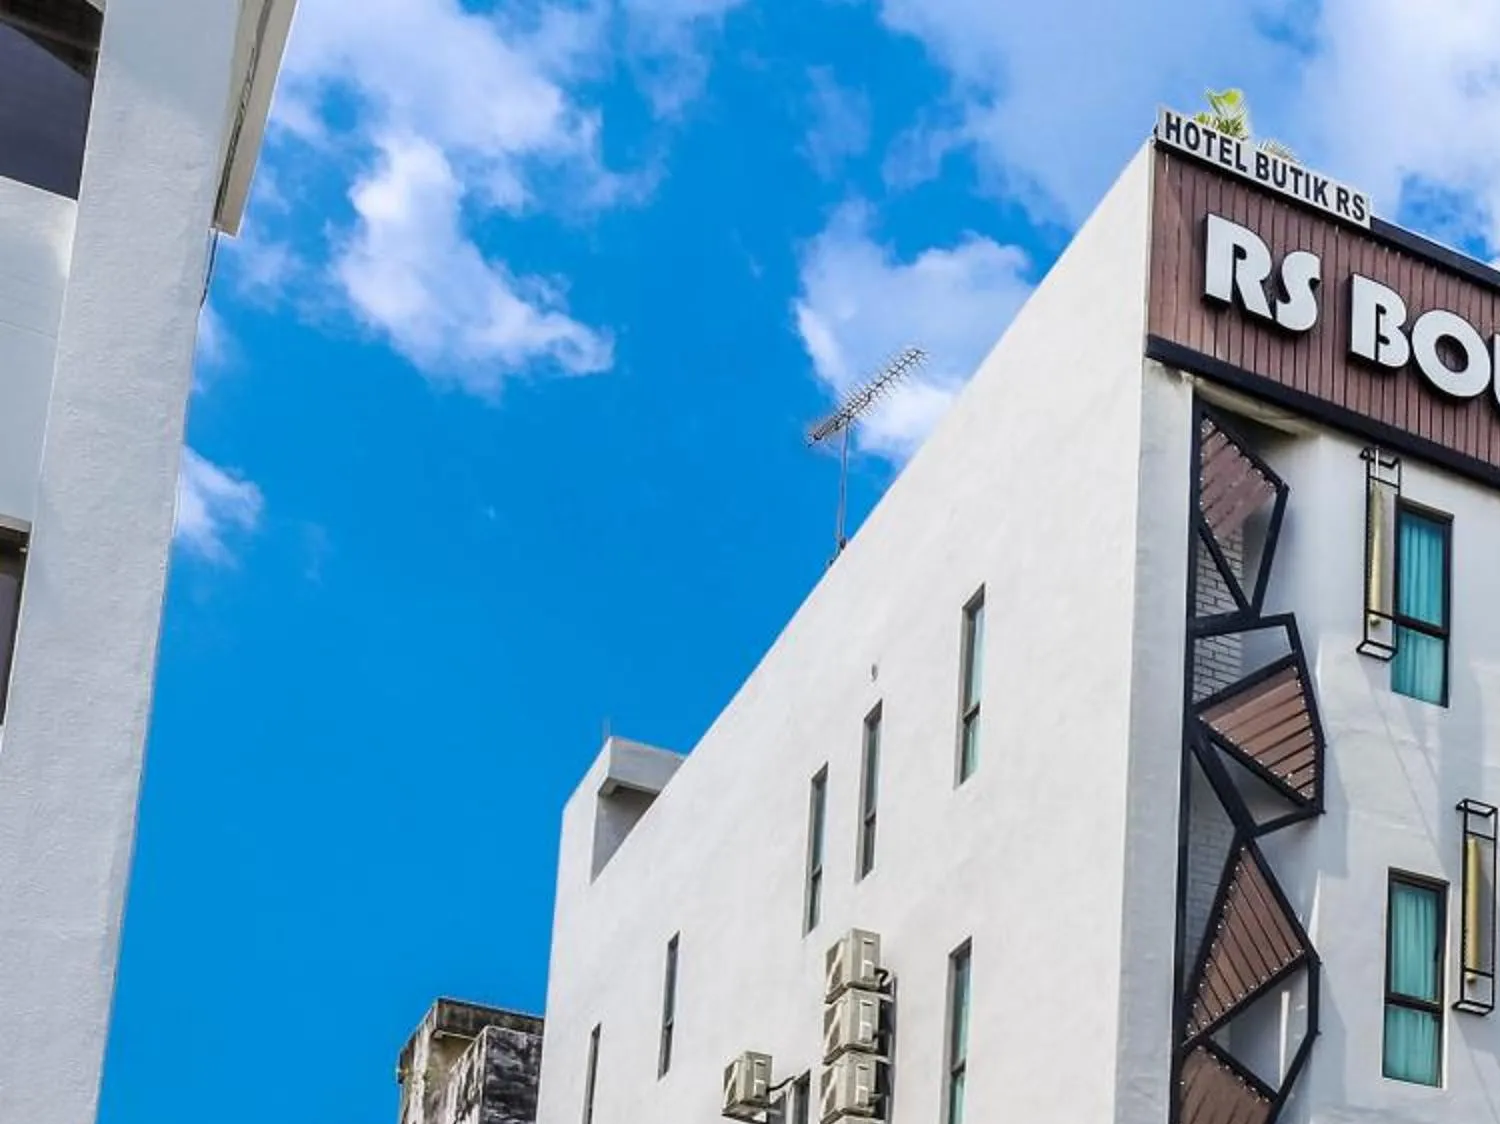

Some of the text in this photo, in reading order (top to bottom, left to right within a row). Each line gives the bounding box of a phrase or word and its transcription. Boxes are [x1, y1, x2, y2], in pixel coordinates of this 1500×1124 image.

[1165, 111, 1366, 222] HOTEL BUTIK RS
[1203, 212, 1322, 332] RS
